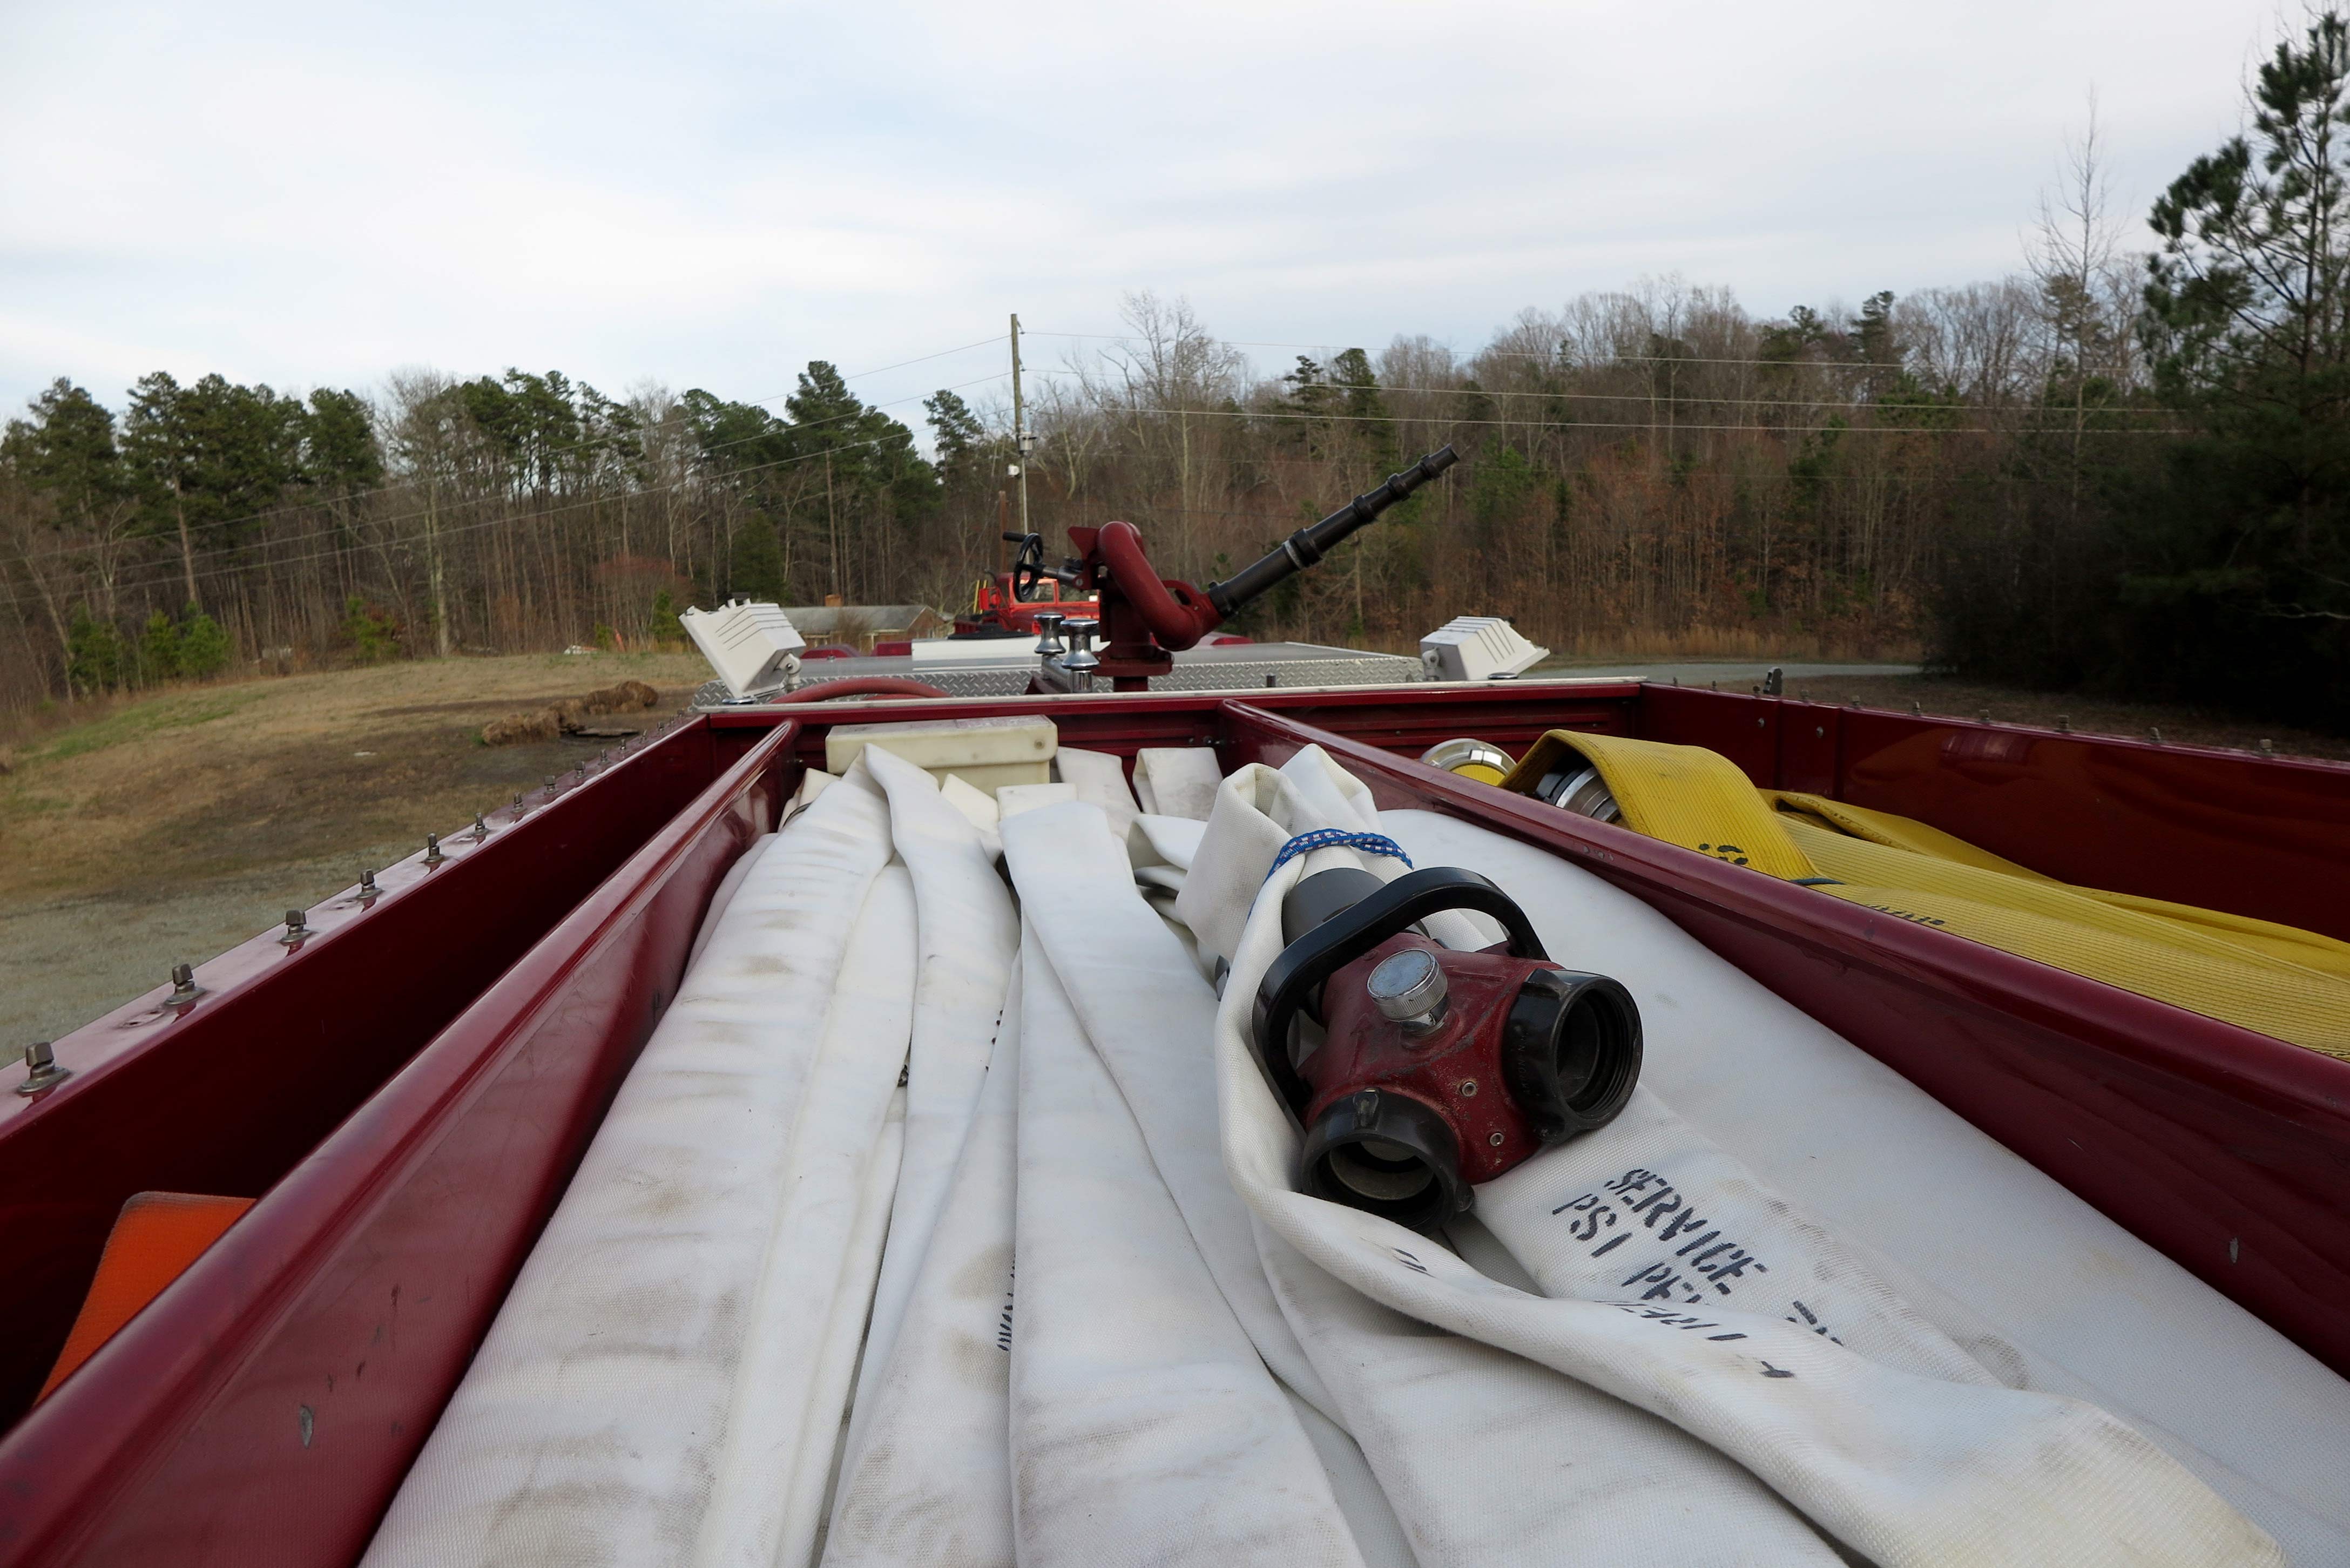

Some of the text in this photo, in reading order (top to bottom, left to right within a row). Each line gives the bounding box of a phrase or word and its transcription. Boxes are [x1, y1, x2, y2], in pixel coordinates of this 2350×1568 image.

[1552, 1193, 1702, 1303] PSI PE
[1604, 1168, 1767, 1295] SERVICE
